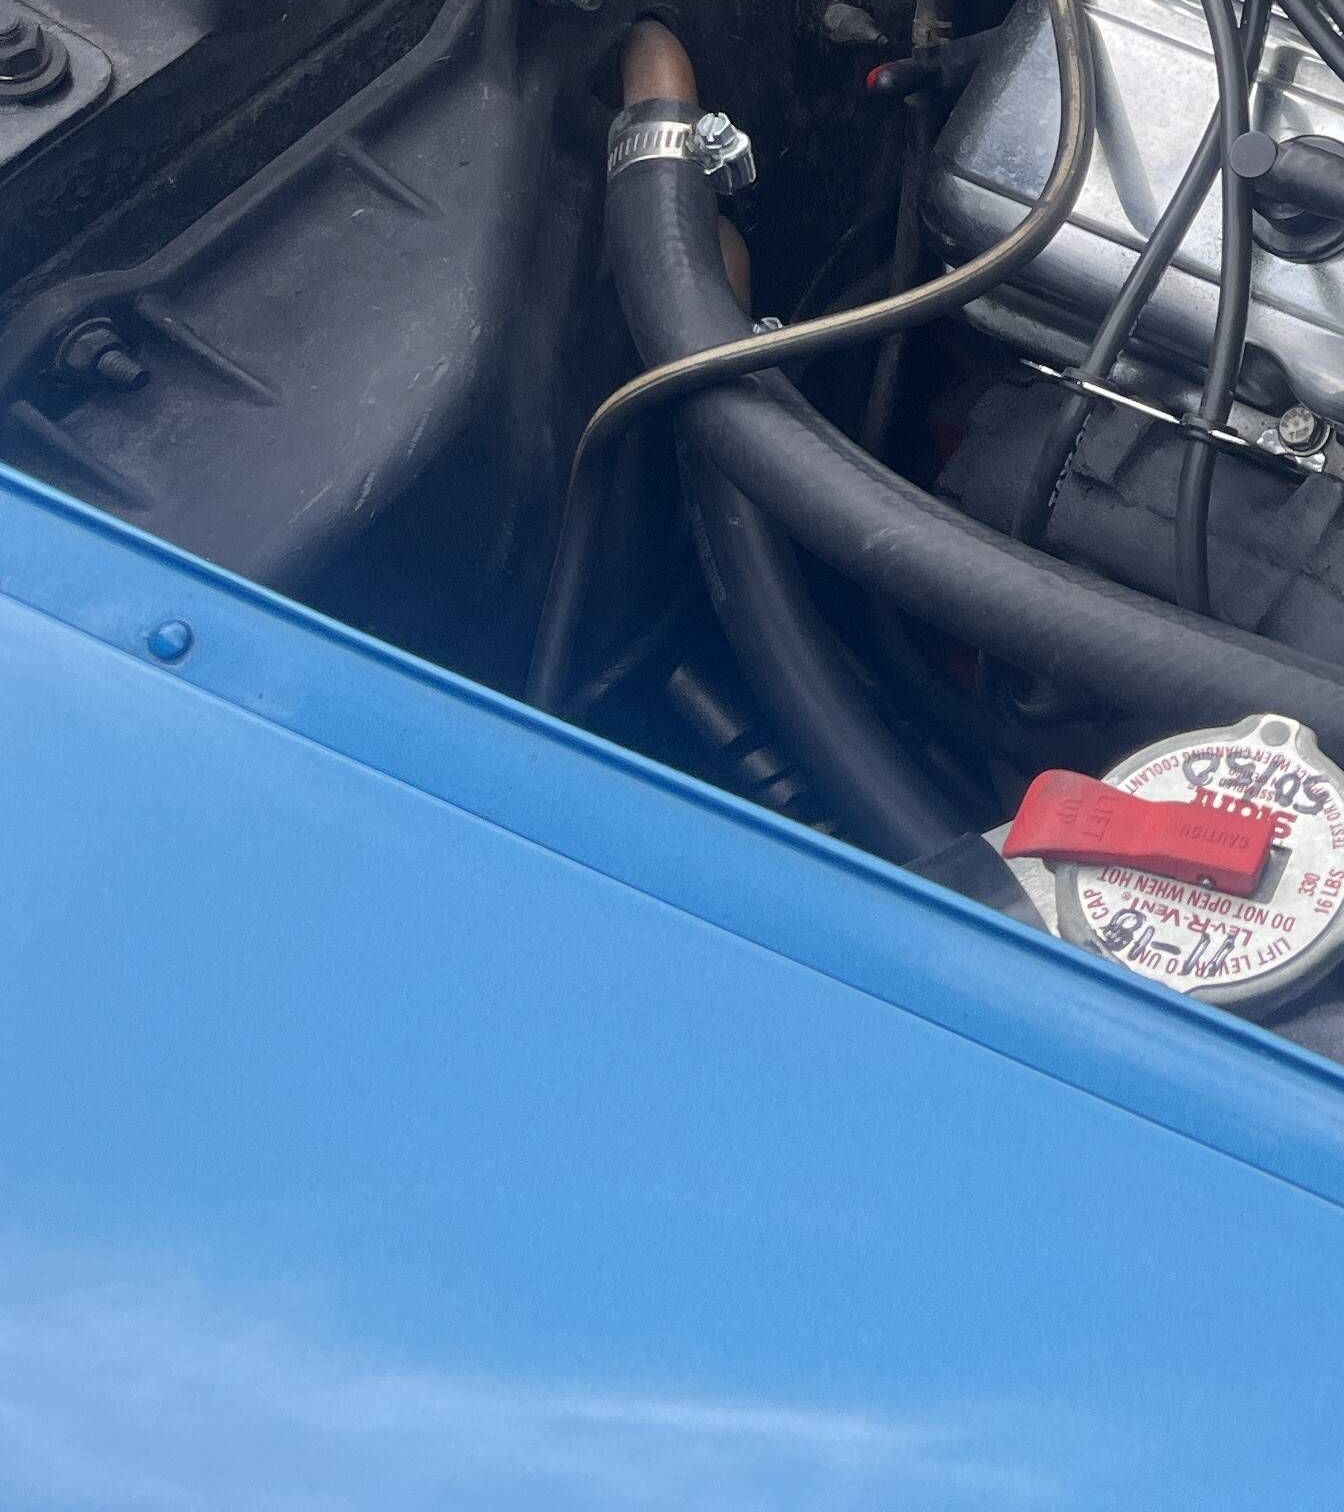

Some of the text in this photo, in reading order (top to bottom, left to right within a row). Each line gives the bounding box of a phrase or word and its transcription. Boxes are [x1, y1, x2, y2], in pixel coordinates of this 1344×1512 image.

[1127, 759, 1180, 796] COOLANT
[1324, 807, 1340, 823] OR
[1180, 825, 1250, 849] CAUTION
[1083, 888, 1110, 921] CAP
[1096, 865, 1297, 933] DO NOT OPEN WHEN HOT
[1315, 897, 1333, 915] 16
[1258, 936, 1292, 967] LIFT
